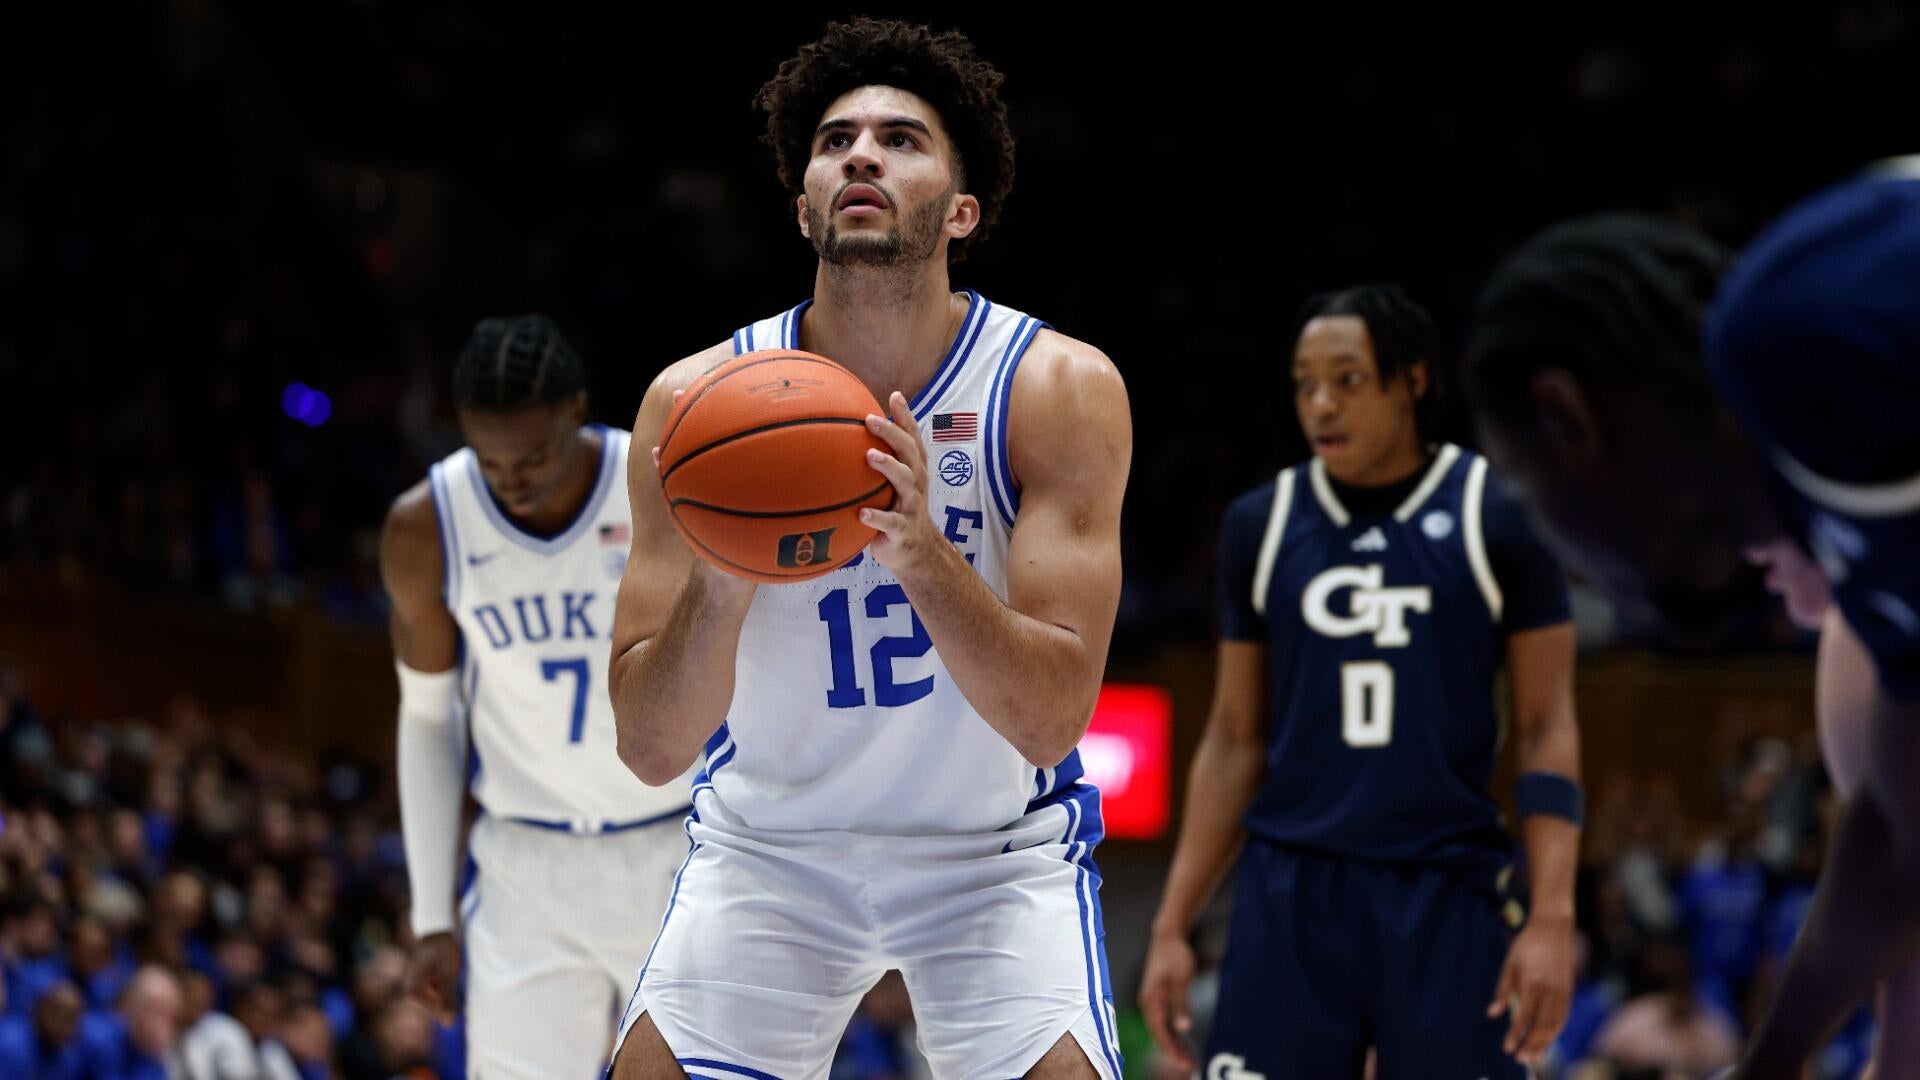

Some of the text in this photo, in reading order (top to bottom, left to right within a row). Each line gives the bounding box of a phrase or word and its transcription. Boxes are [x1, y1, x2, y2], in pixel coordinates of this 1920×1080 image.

[942, 461, 972, 471] ACC
[472, 591, 615, 650] DUK
[818, 583, 935, 708] 12
[1302, 563, 1431, 647] GT
[540, 656, 590, 743] 7
[1340, 660, 1394, 747] 0
